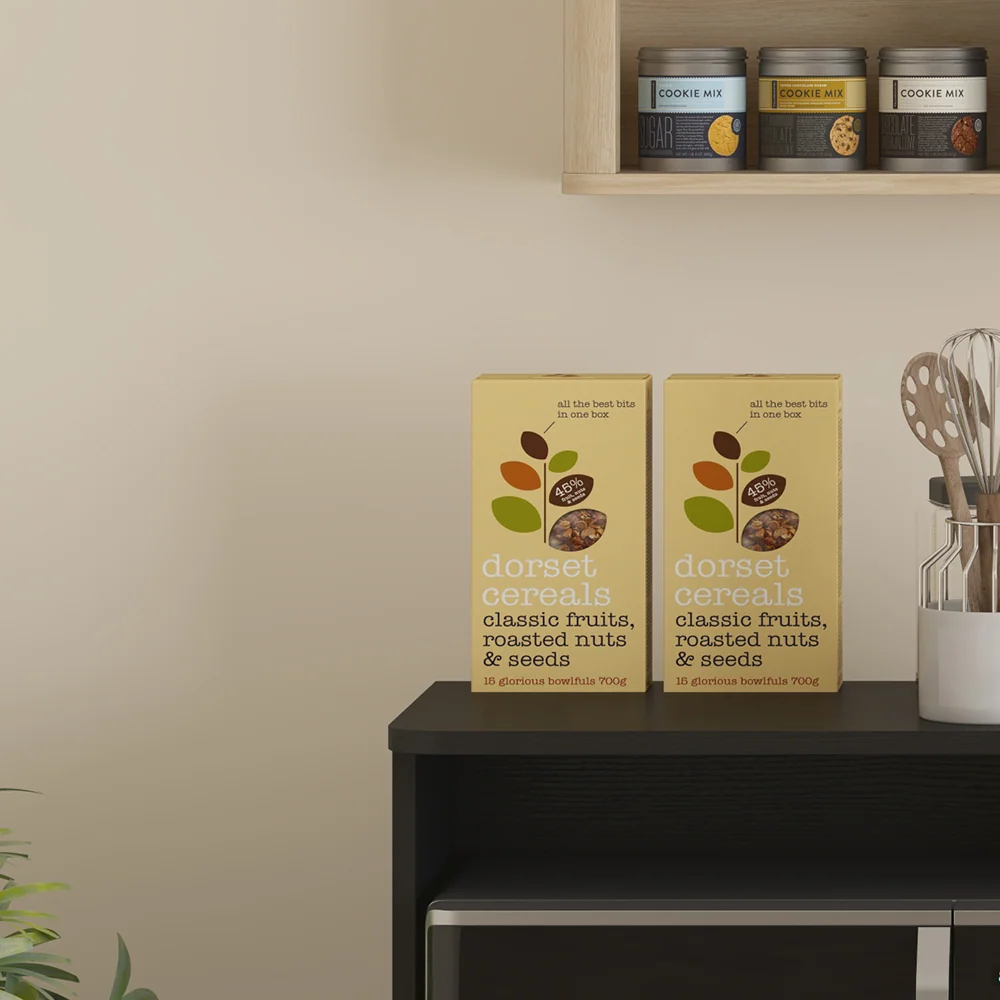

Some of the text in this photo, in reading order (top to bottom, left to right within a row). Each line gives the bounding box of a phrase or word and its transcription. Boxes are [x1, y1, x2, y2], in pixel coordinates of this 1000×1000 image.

[658, 89, 722, 98] COOKIE MIX
[780, 89, 843, 98] COOKIE MIX
[900, 89, 964, 98] COOKIE MIX
[556, 477, 584, 497] 45%
[748, 477, 776, 497] 45%
[482, 553, 597, 578] dorset
[675, 553, 789, 578] dorset
[482, 582, 611, 606] cereals
[674, 582, 803, 606] cereals
[483, 612, 635, 630] classic fruits,
[675, 612, 827, 630] classic fruits,
[483, 632, 626, 647] roasted nuts
[675, 632, 819, 647] roasted nuts
[483, 652, 570, 667] & seeds
[676, 652, 763, 667] & seeds
[484, 676, 627, 687] 15 glorious bowlfuls 700g
[676, 676, 819, 687] 15 glorious bowlfuls 700g
